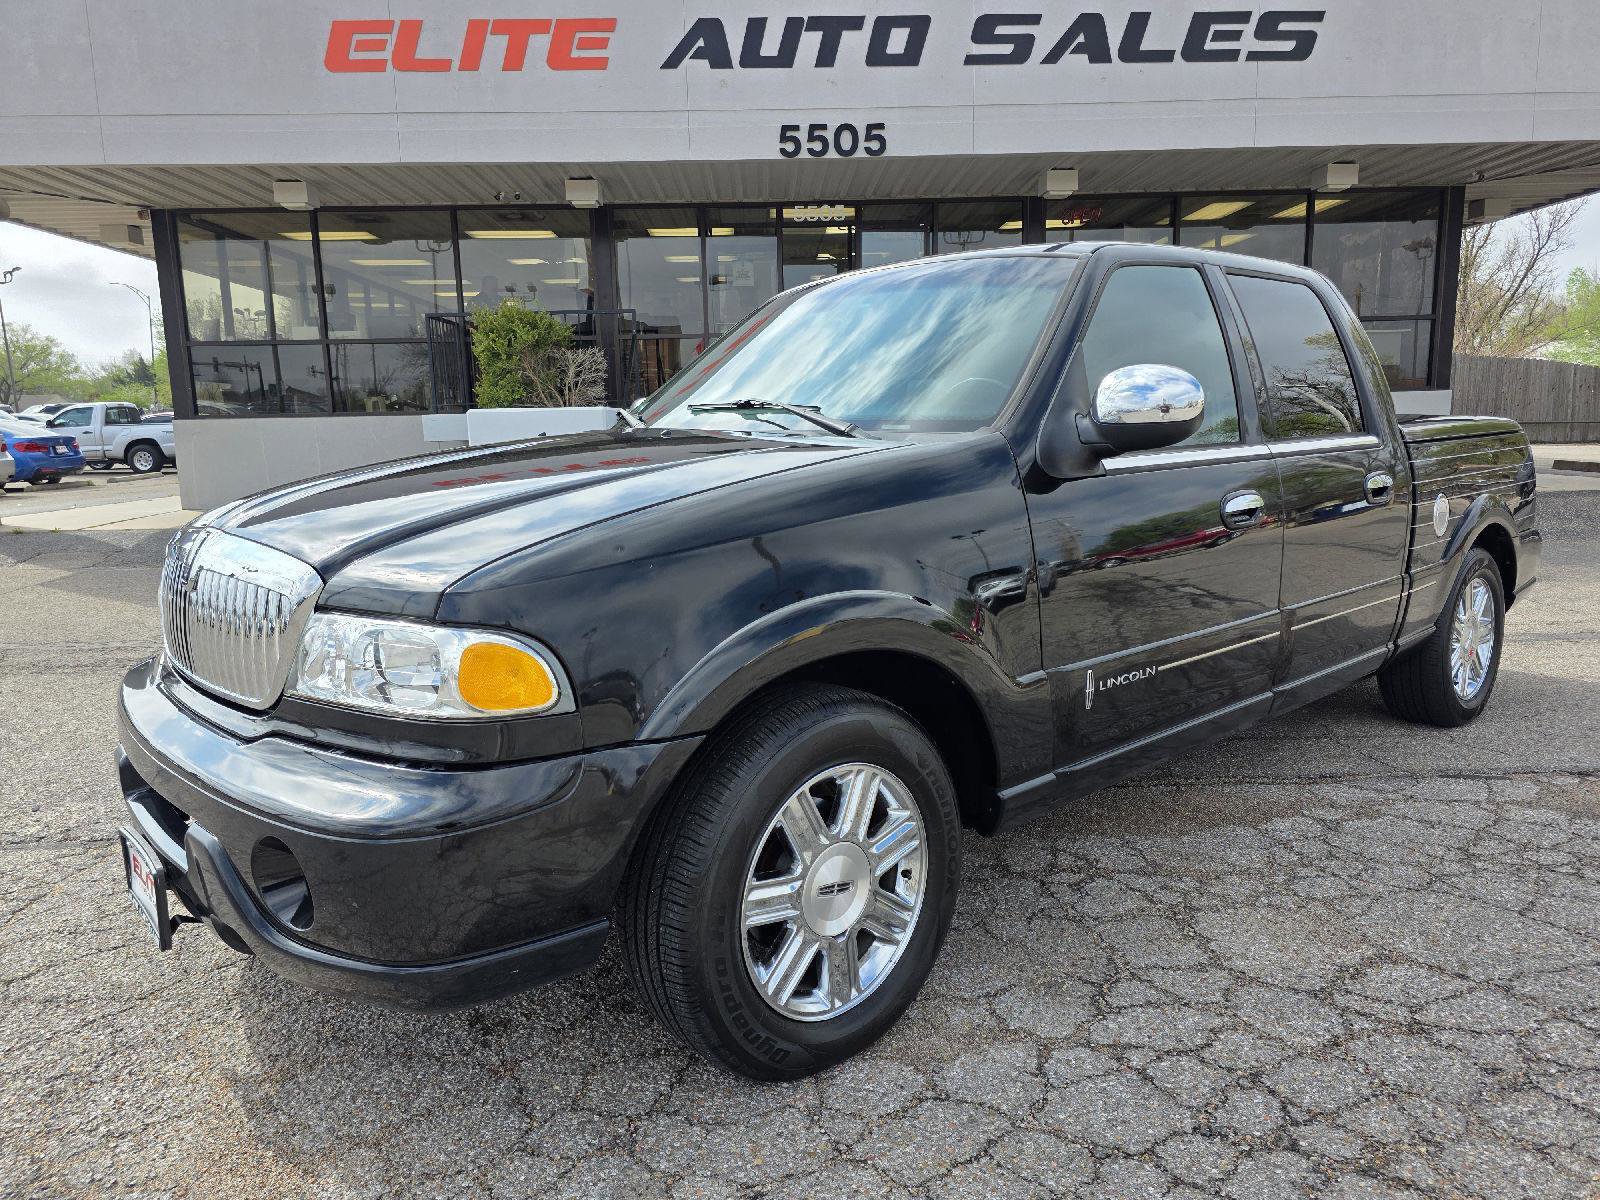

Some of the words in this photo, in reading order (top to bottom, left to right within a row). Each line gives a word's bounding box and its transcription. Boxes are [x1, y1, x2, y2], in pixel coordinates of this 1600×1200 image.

[323, 18, 617, 73] ELITE
[660, 15, 931, 70] AUTO
[963, 10, 1326, 66] SALES
[778, 123, 888, 158] 5505
[793, 204, 846, 221] 5505
[1100, 665, 1156, 691] LINCOLN
